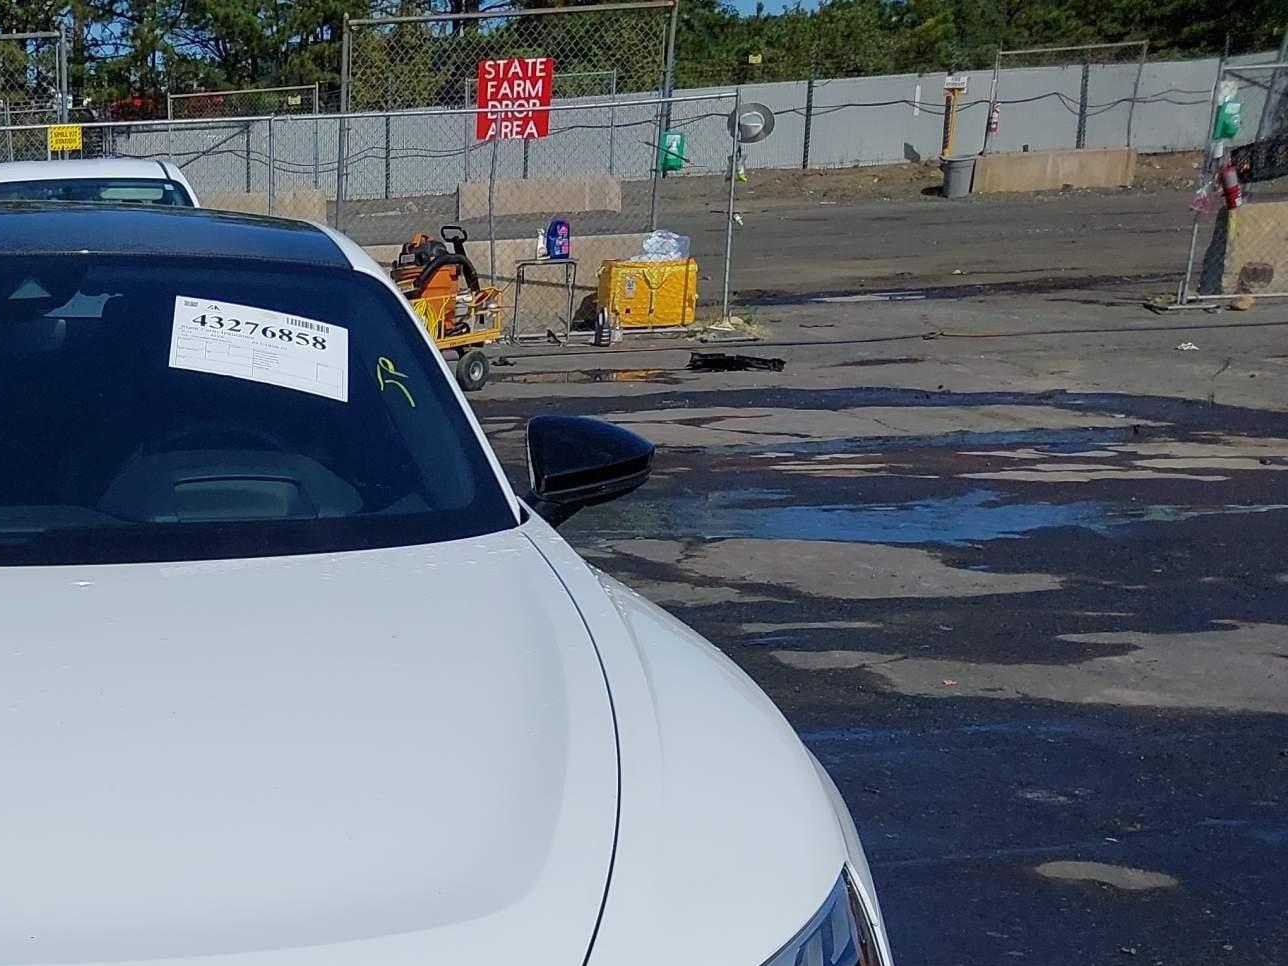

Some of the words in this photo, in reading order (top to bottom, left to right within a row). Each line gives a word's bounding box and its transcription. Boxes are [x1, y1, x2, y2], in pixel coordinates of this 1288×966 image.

[484, 58, 547, 79] STATE
[487, 79, 544, 100] FARM
[487, 99, 540, 119] DROP
[485, 120, 539, 141] AREA
[192, 313, 328, 351] 43276858
